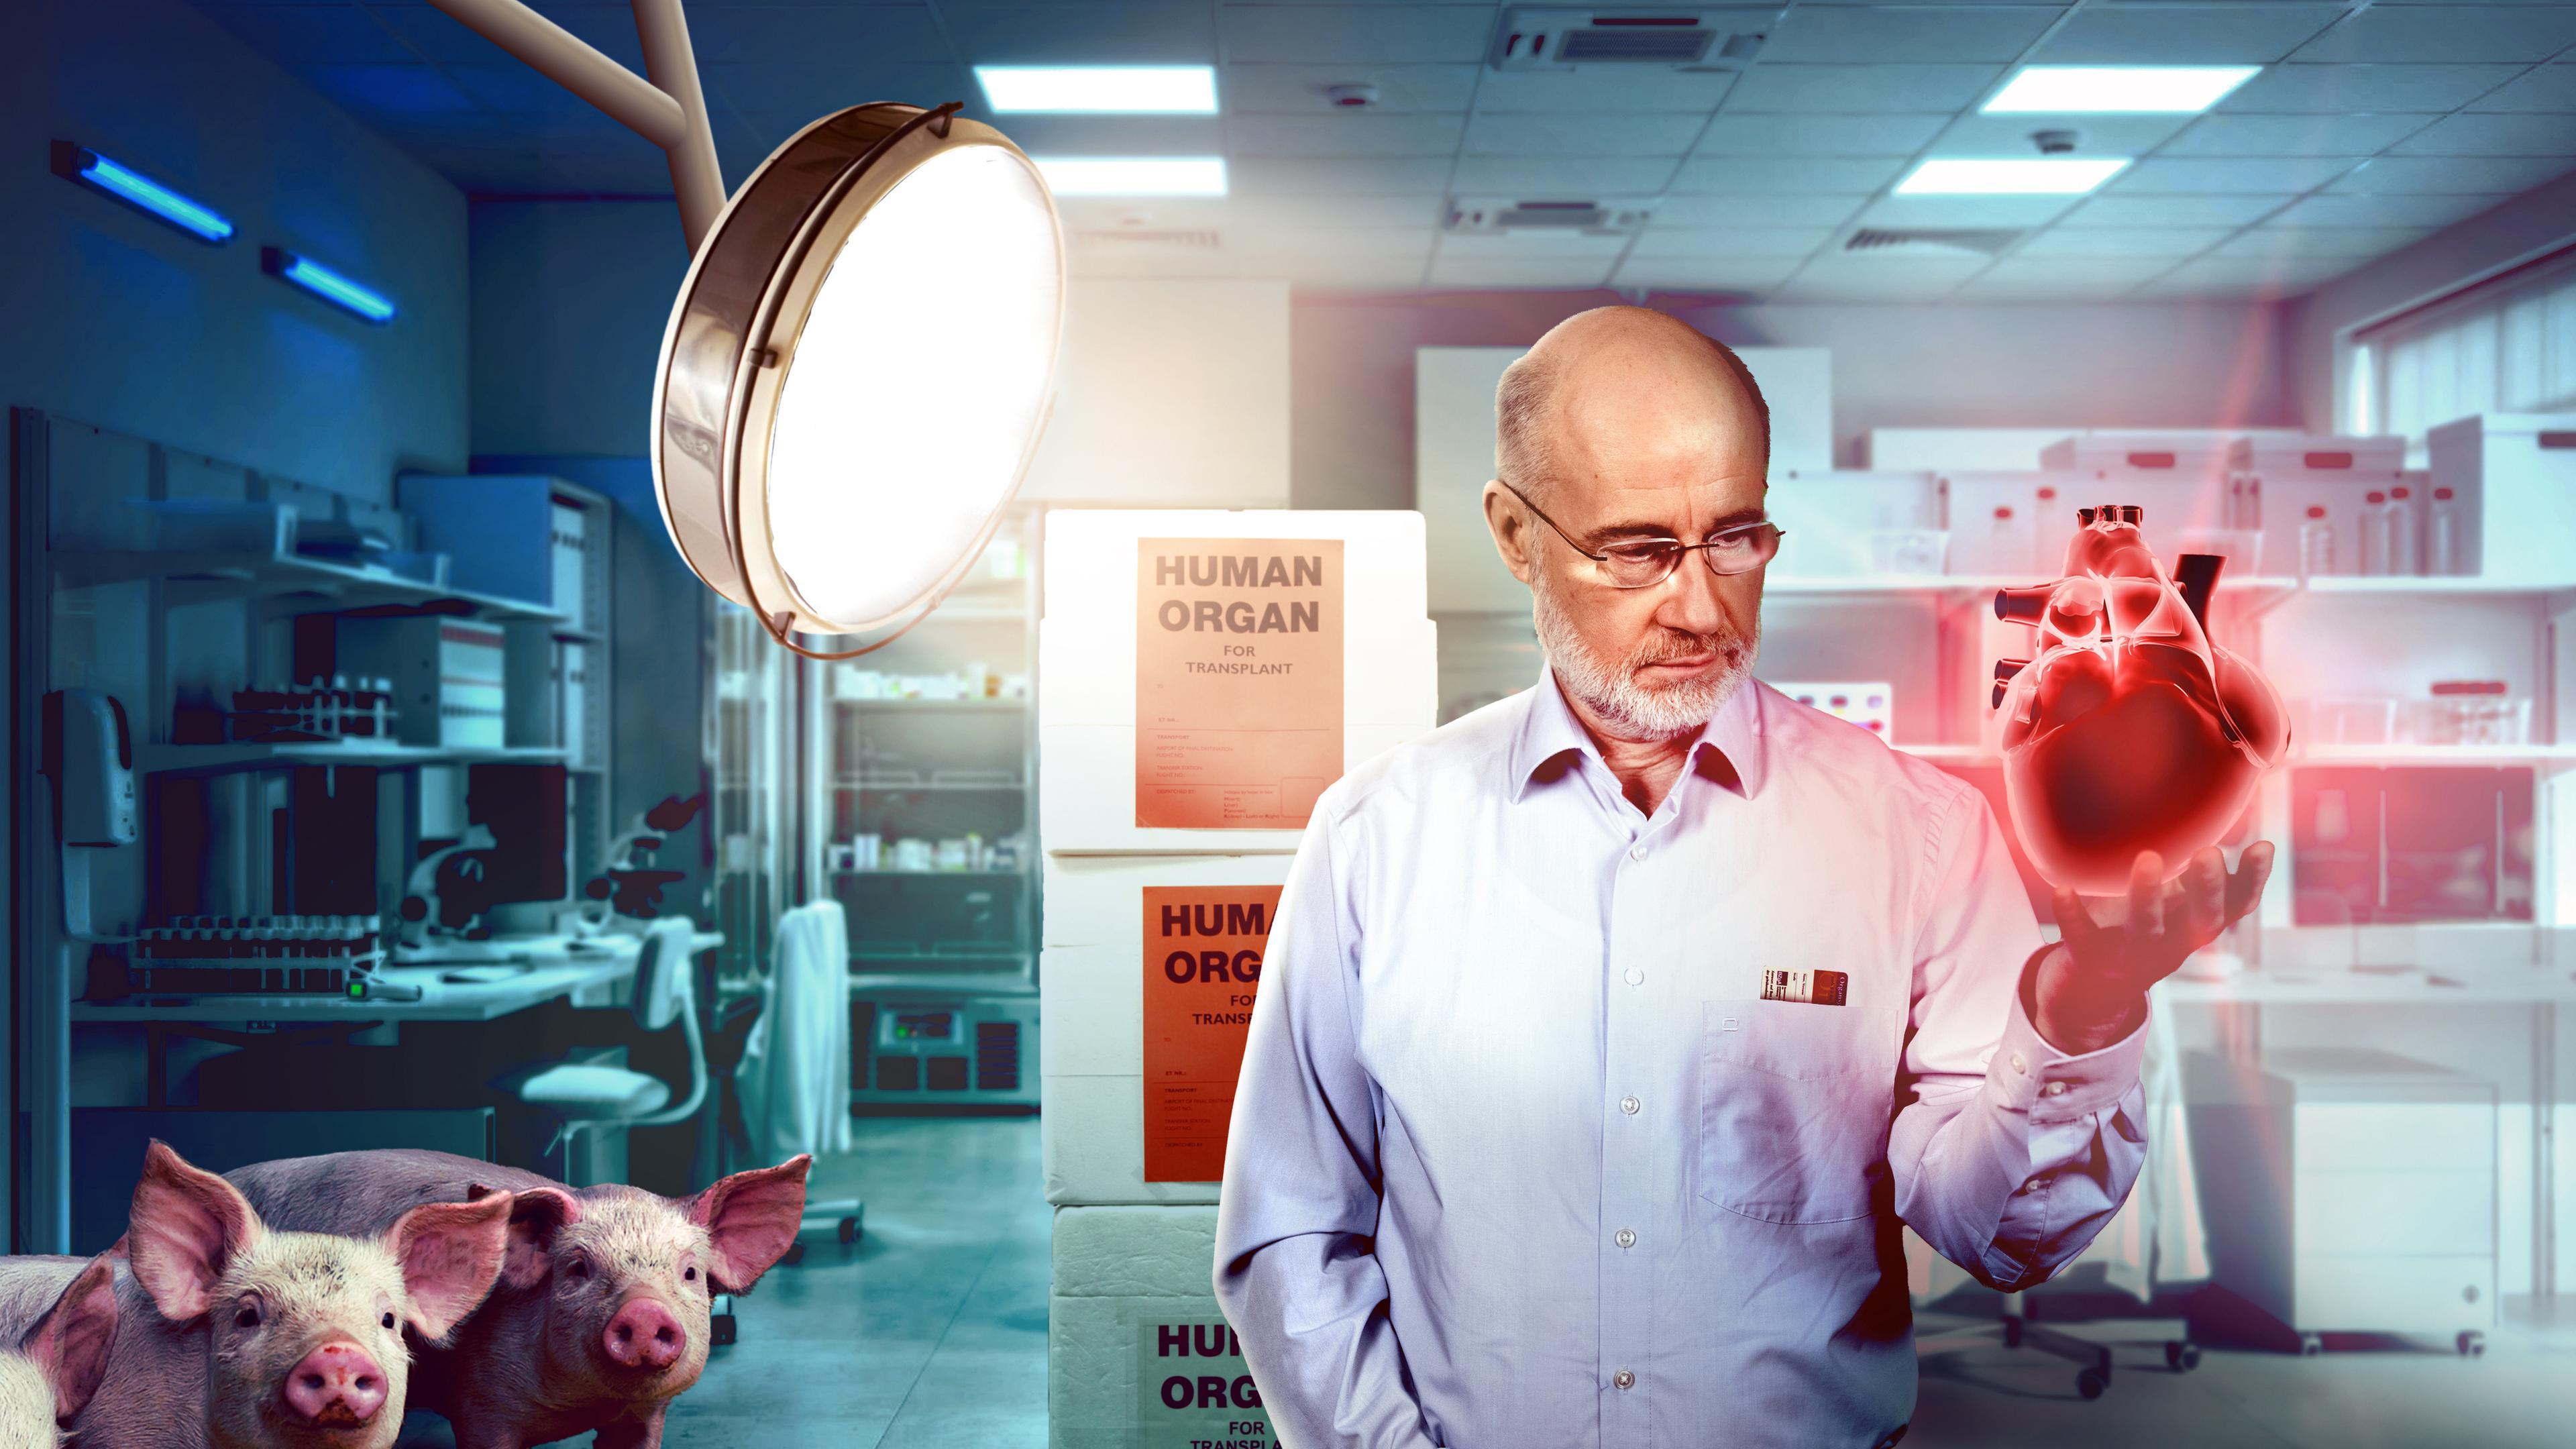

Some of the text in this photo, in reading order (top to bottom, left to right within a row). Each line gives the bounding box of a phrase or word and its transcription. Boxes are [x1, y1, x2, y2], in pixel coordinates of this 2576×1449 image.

[1156, 555, 1322, 587] HUMAN
[1159, 600, 1319, 633] ORGAN
[1224, 645, 1255, 657] FOR
[1185, 661, 1293, 675] TRANSPLANT
[1162, 903, 1278, 936] HUM
[1165, 950, 1262, 983] ORG
[1161, 1375, 1263, 1409] ORG
[1229, 1421, 1265, 1435] FOR
